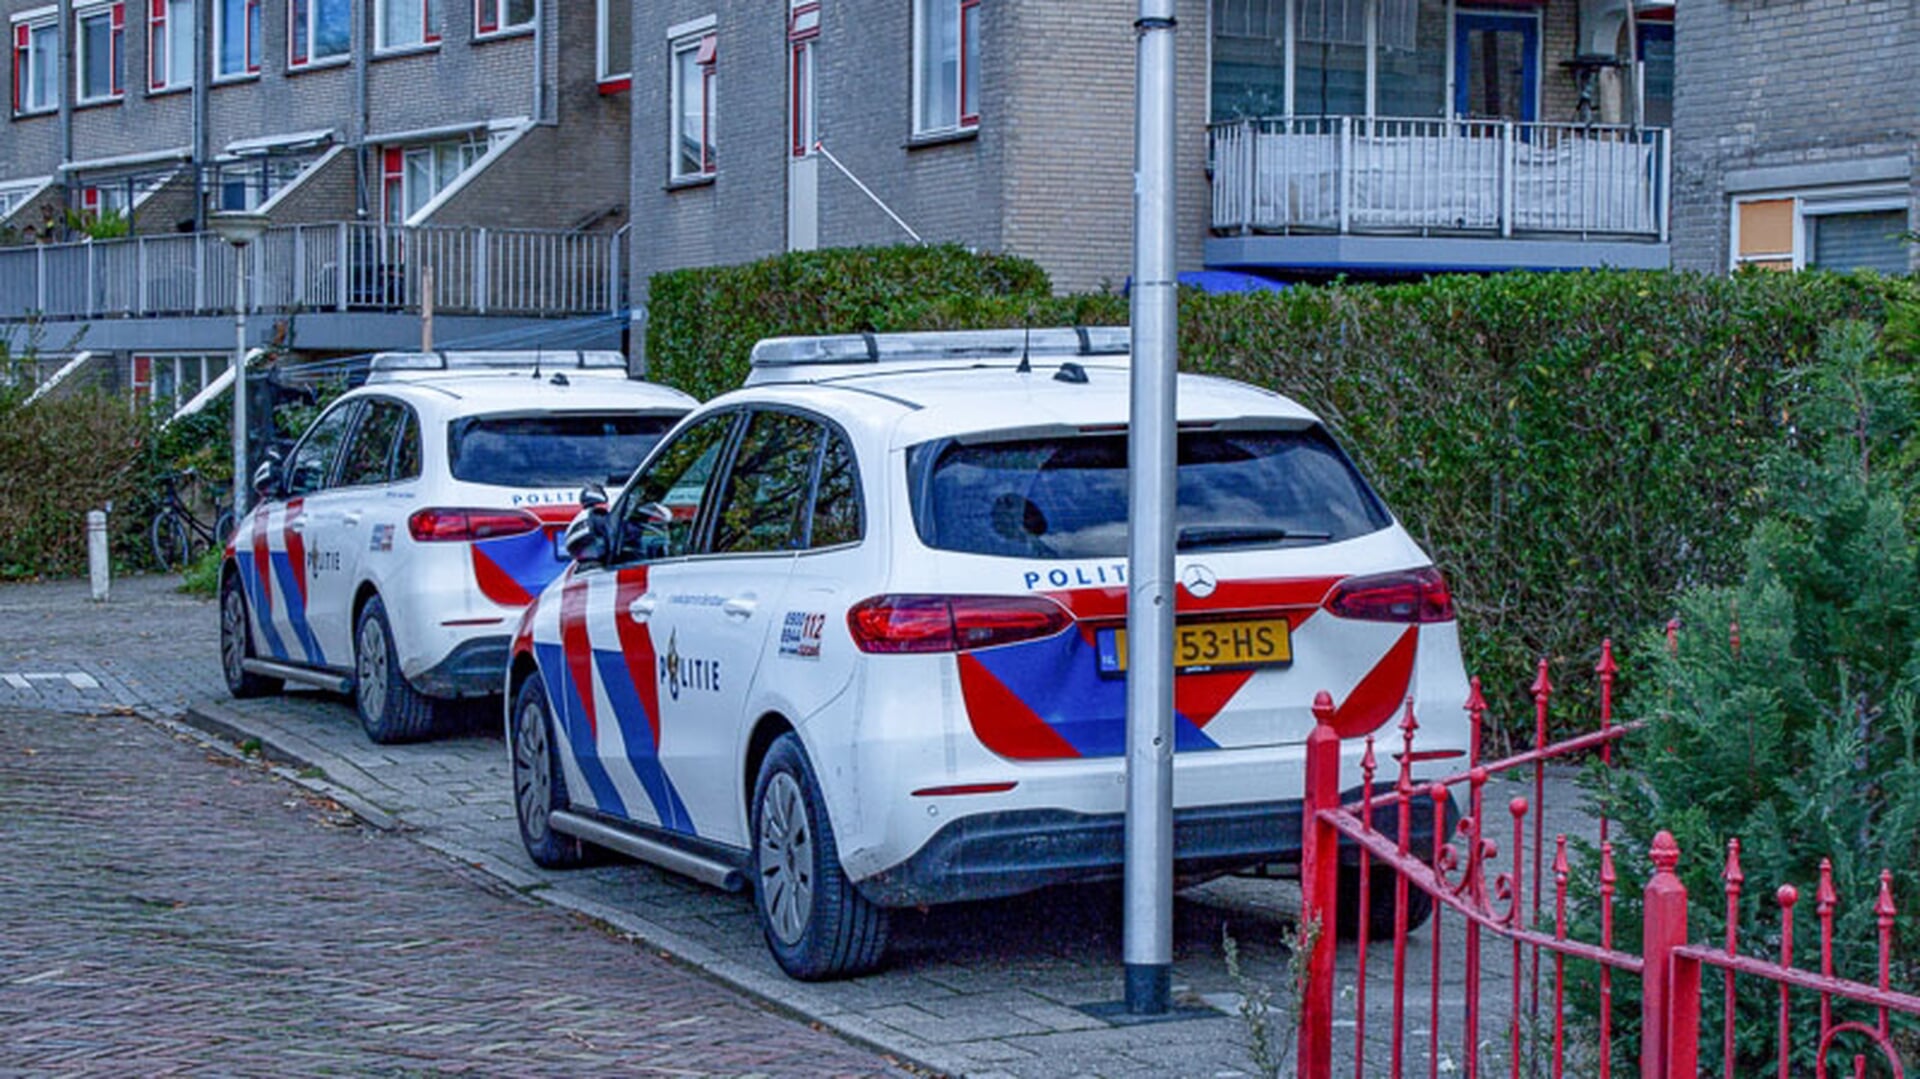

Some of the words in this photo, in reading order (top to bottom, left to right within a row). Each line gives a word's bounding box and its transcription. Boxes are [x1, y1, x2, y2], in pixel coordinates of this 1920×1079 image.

[512, 492, 573, 506] POLIT
[1024, 564, 1126, 590] POLIT
[802, 612, 826, 640] 112
[1180, 625, 1275, 661] 53-HS
